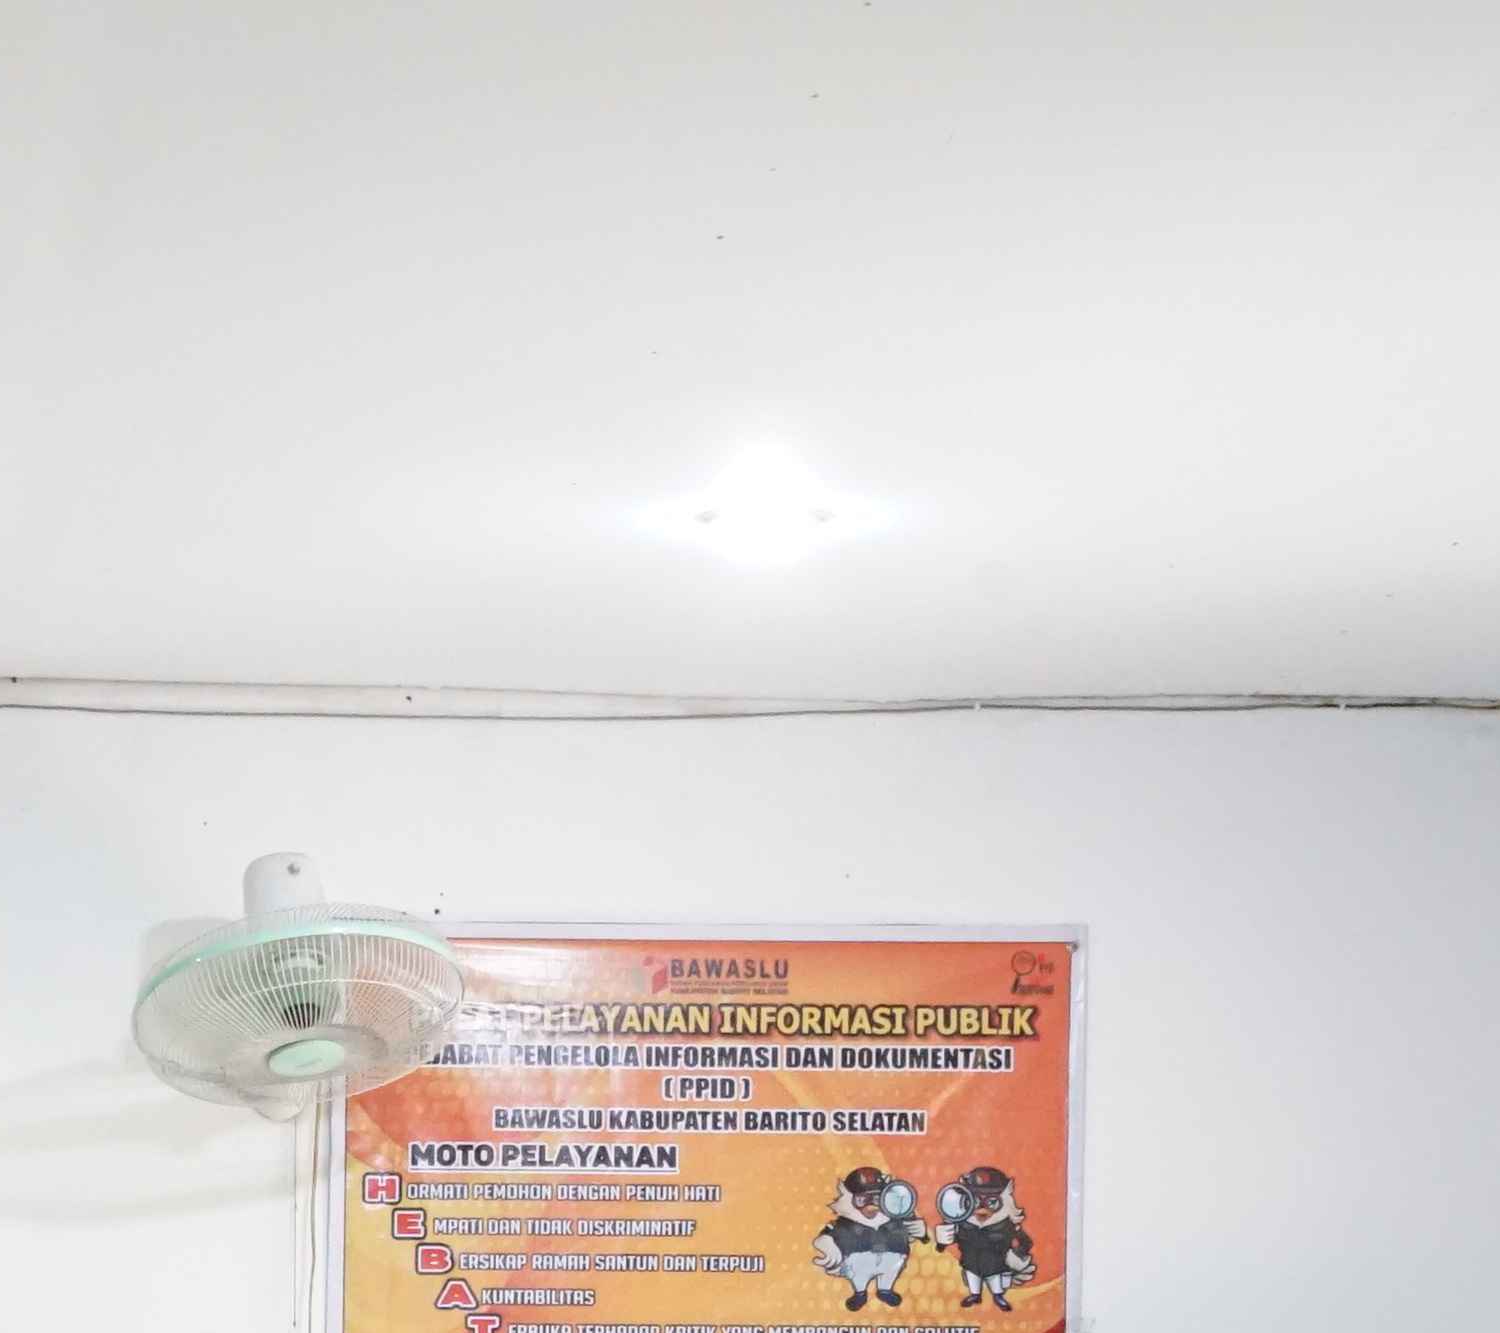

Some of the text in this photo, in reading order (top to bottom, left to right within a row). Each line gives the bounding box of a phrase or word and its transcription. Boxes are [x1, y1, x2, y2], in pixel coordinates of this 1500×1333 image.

[671, 959, 788, 979] BAWASLU
[719, 1006, 907, 1035] INFORMASI
[915, 1007, 1036, 1036] PUBLIK
[509, 1045, 639, 1067] PENGELOLA
[646, 1046, 778, 1068] INFORMASI
[786, 1047, 833, 1069] DAN
[841, 1047, 1012, 1070] DOKUMENTASI
[679, 1077, 735, 1099] PPID
[494, 1109, 925, 1132] BAWASLU KABUPATEN BARITO SELATAN
[411, 1144, 678, 1169] MOTO PELAYANAN
[473, 1184, 552, 1201] PEMOHON
[557, 1185, 621, 1202] DENGAN
[626, 1185, 680, 1202] PENUH
[684, 1185, 721, 1202] HATI
[488, 1219, 522, 1236] DAN
[526, 1219, 573, 1236] TIDAK
[578, 1219, 697, 1237] DISKRIMINATIF
[532, 1254, 590, 1271] RAMAH
[595, 1255, 658, 1271] SANTUN
[663, 1255, 697, 1272] DAN
[701, 1256, 765, 1273] TERPUJI
